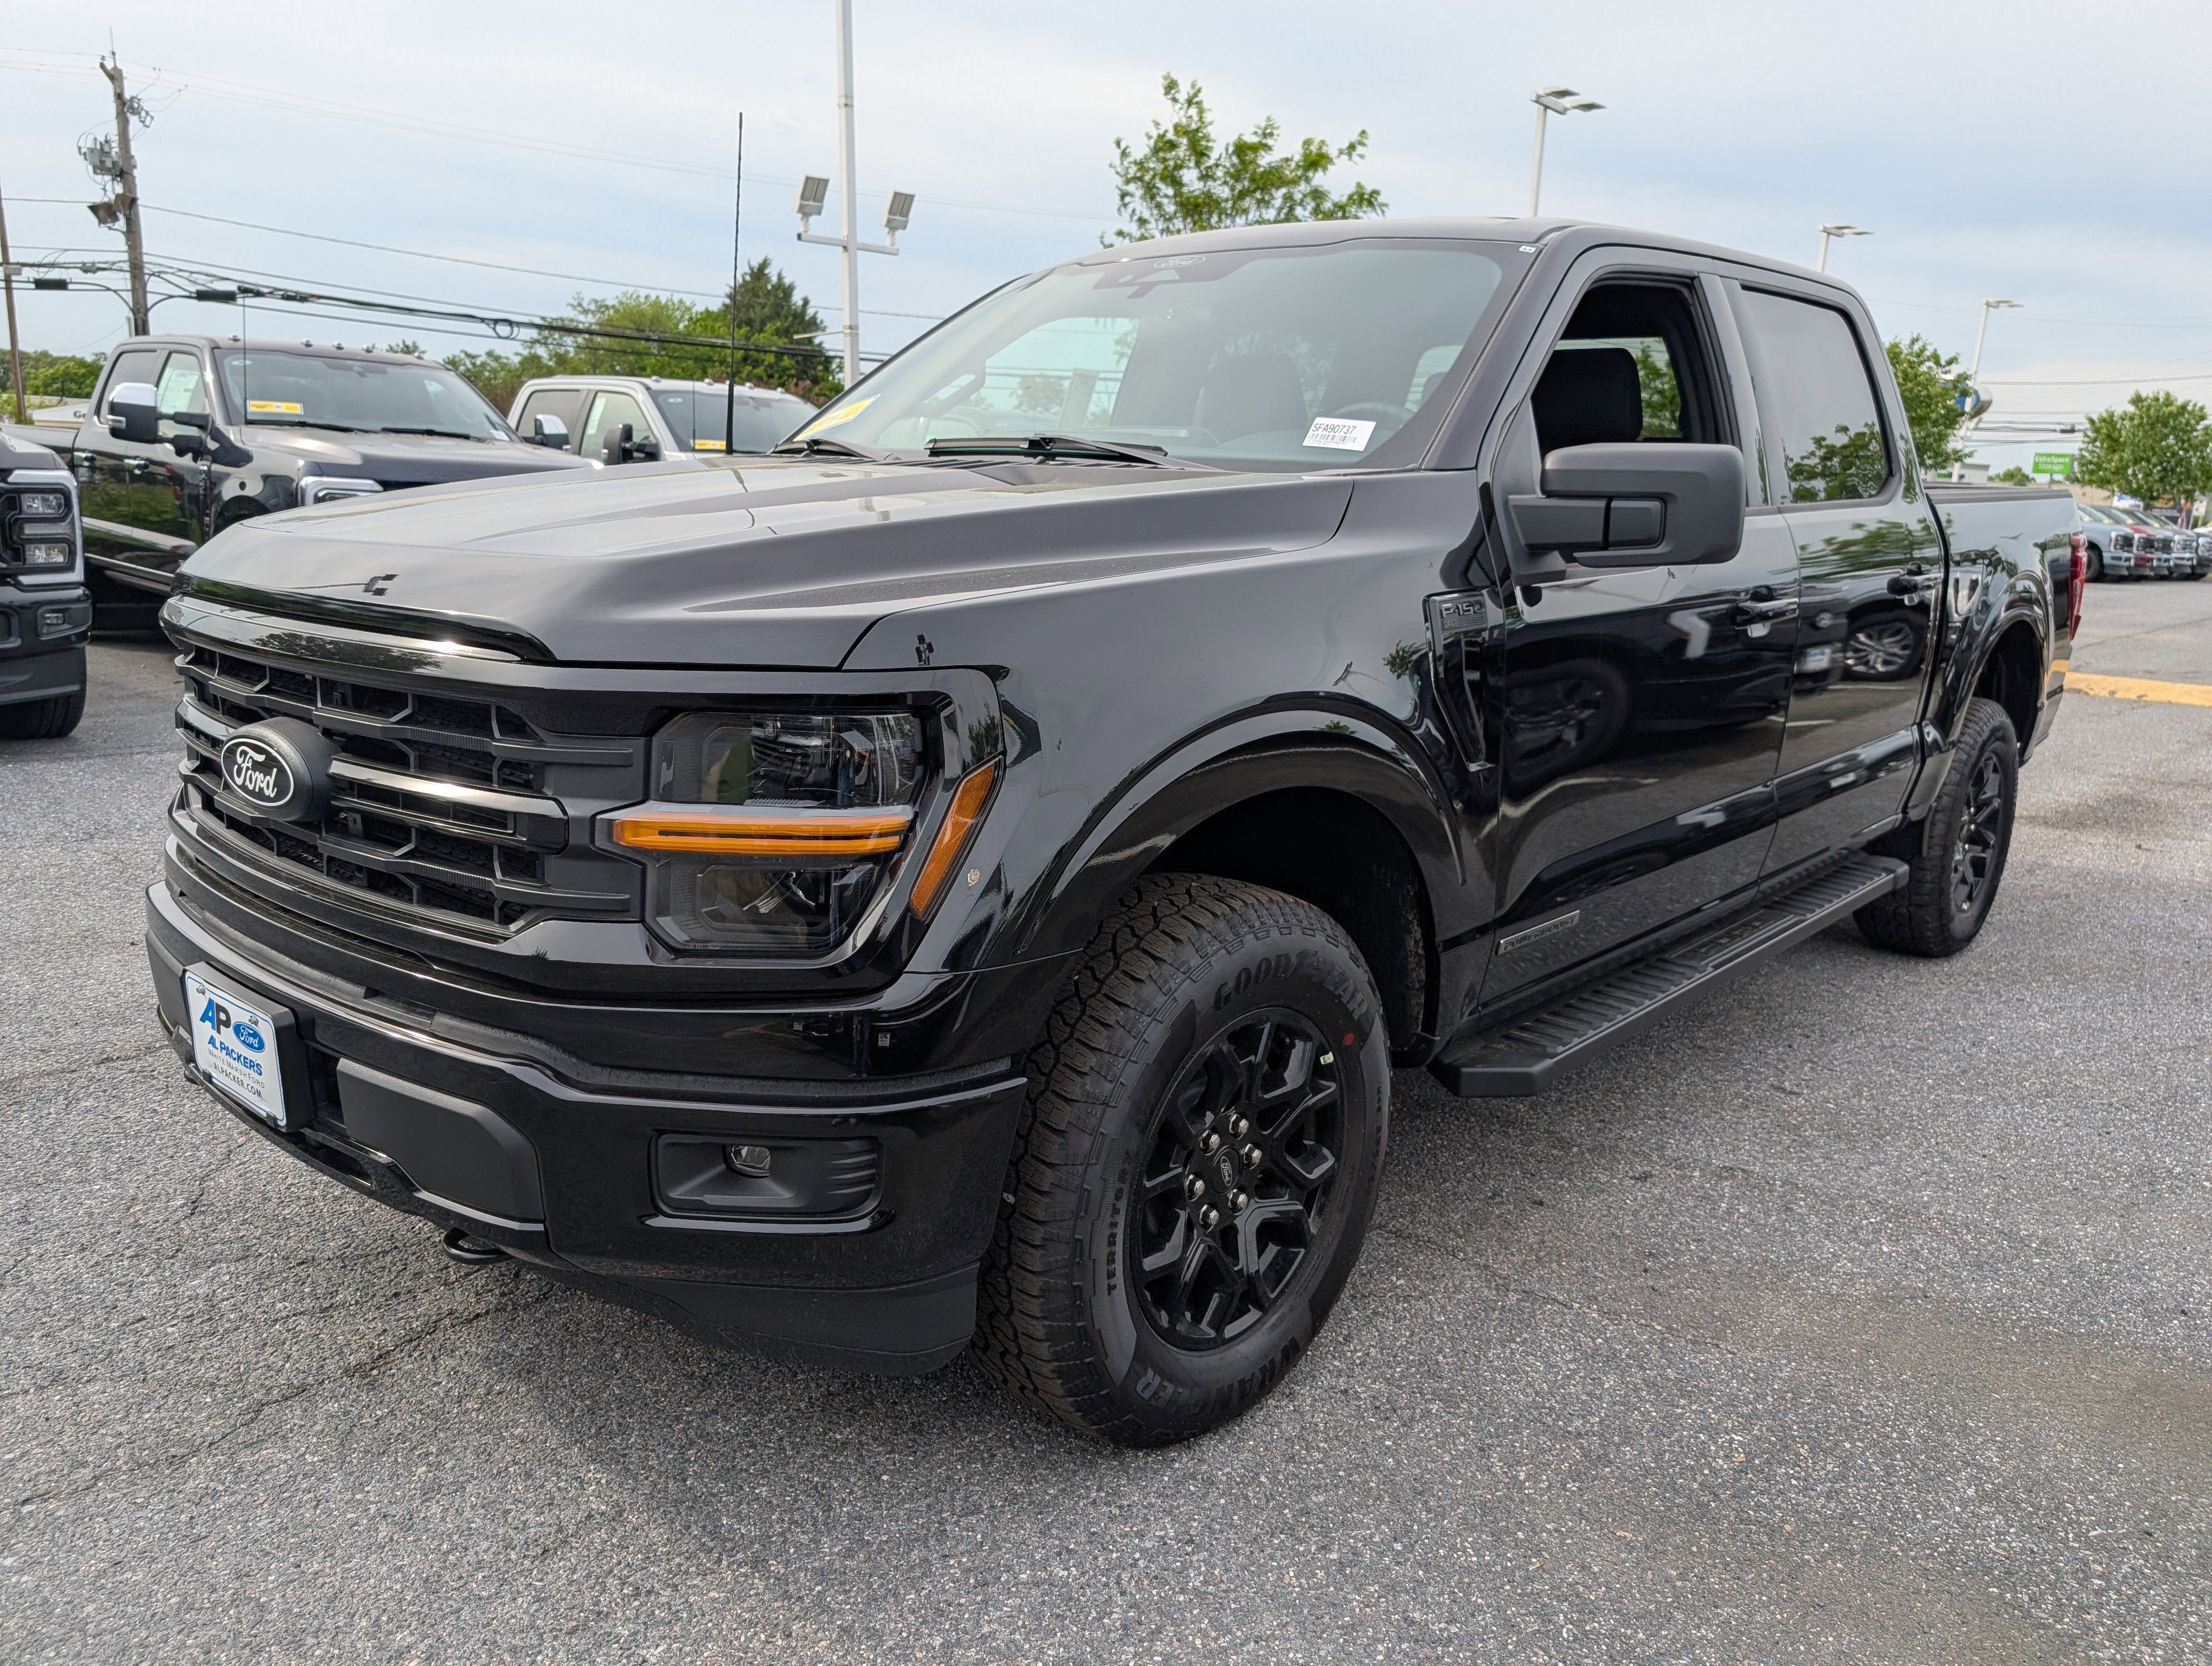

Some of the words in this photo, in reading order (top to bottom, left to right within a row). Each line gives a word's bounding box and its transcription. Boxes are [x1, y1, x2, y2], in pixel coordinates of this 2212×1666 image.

[1440, 600, 1486, 618] F-150
[234, 745, 277, 798] Ford
[1214, 948, 1368, 1021] GOODYEAR
[199, 997, 232, 1036] AP
[208, 1034, 218, 1051] AL
[220, 1040, 263, 1077] PACKER'S
[208, 1047, 226, 1065] WHITE
[226, 1059, 247, 1078] MARSH
[248, 1073, 265, 1088] FORD
[214, 1061, 263, 1100] ALPACKER.COM
